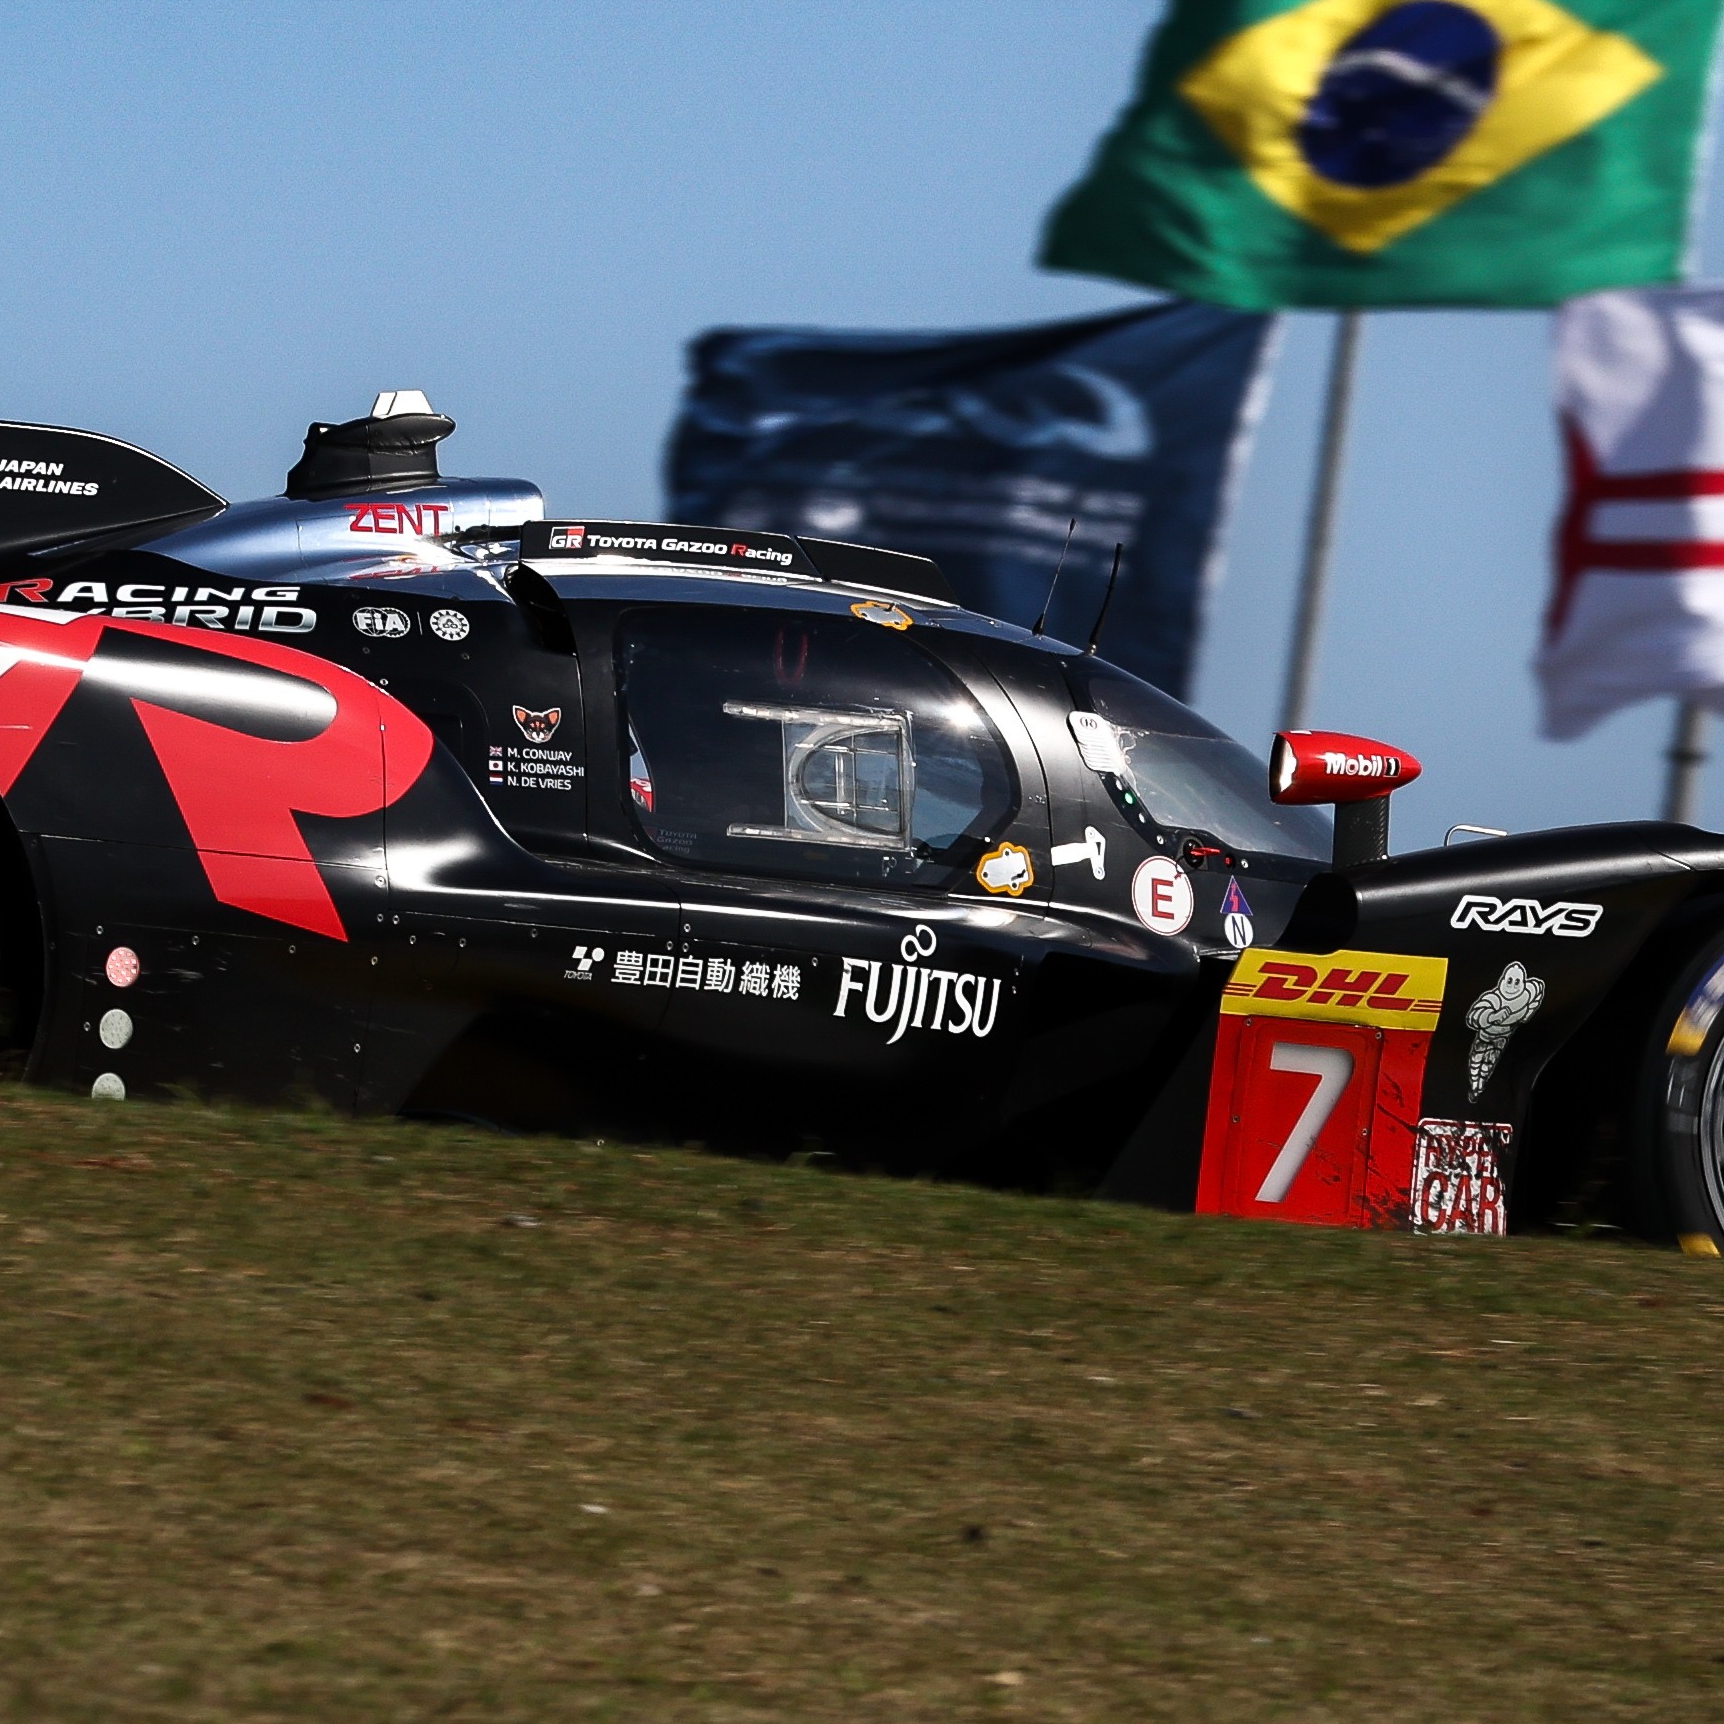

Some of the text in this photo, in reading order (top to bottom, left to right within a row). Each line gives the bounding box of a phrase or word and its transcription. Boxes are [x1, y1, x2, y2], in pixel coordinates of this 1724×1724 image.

[343, 502, 449, 538] ZENT
[551, 534, 793, 566] GR TOYOTA GAZOO Racing
[86, 605, 318, 633] BRID
[507, 746, 573, 762] M. CONWAY
[507, 761, 585, 777] K. KOBAYASHI
[1323, 752, 1383, 777] Mobil
[507, 775, 572, 791] N. DE VRIES
[1151, 877, 1175, 921] E
[1451, 894, 1604, 938] RAYS
[1231, 915, 1247, 946] N
[611, 950, 802, 1001] 豊田自動織機
[1252, 961, 1416, 1011] DHL
[833, 956, 1002, 1045] FUJITSU
[1254, 1042, 1356, 1203] 7
[1420, 1170, 1502, 1234] CAR
